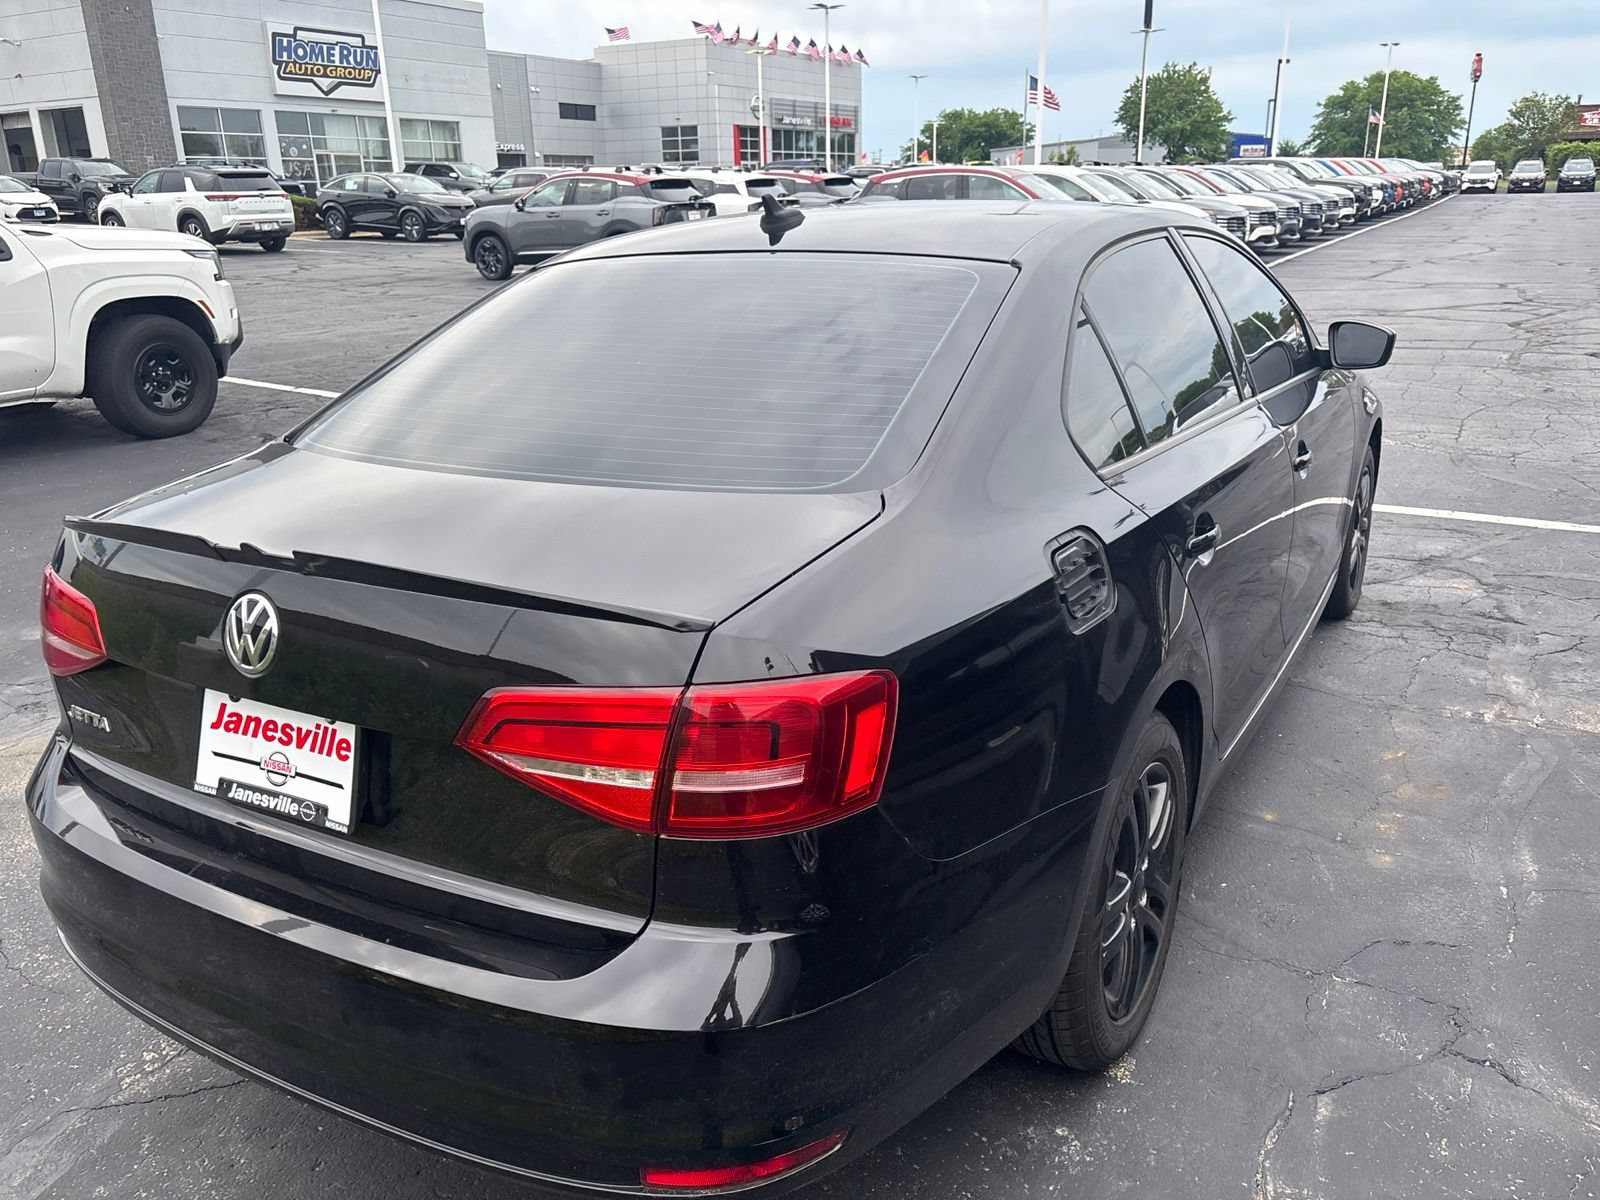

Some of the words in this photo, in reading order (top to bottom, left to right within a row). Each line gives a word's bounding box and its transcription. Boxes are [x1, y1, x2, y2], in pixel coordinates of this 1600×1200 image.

[276, 37, 337, 64] HOME
[338, 43, 379, 70] RUN
[286, 62, 324, 76] AUTO
[326, 66, 372, 80] GROUP
[67, 704, 111, 733] JETTA
[210, 702, 351, 762] Janesville
[263, 759, 292, 774] NISSAN
[193, 783, 217, 796] NISSAN
[228, 783, 299, 816] Janesville
[325, 820, 348, 834] NISSAN
